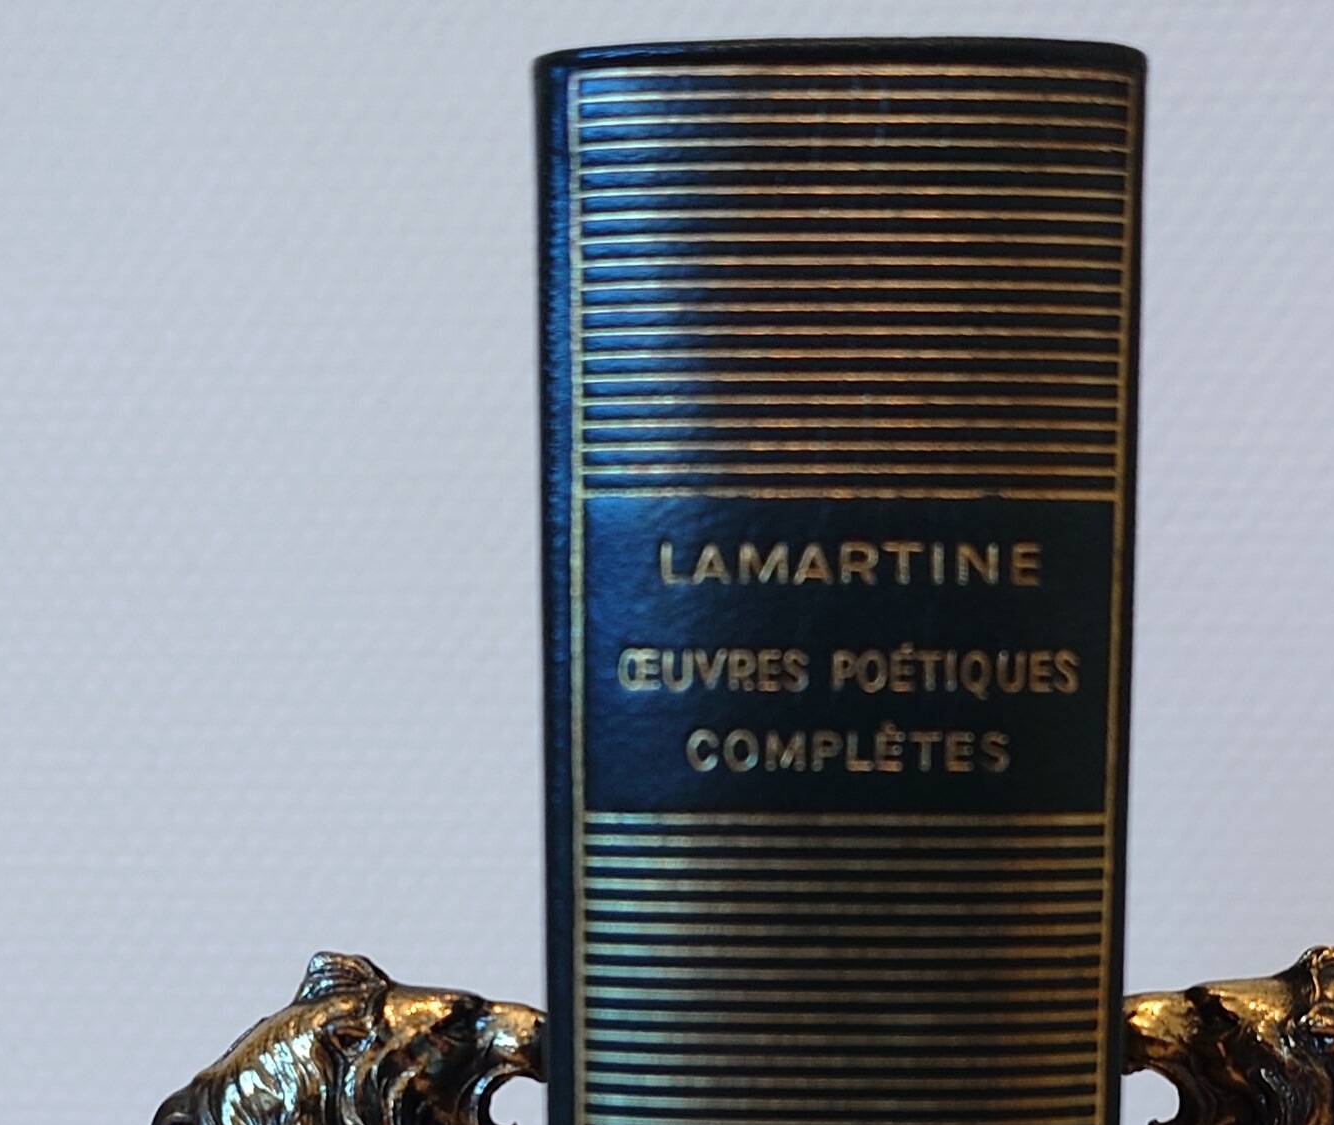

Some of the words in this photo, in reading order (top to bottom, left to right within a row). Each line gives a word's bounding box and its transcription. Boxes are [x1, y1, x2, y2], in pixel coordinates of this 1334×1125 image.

[658, 541, 1043, 586] LAMARTINE
[616, 646, 810, 693] ŒUVRES
[830, 641, 1080, 700] POÉTIQUES
[685, 721, 1011, 772] COMPLÈTES
